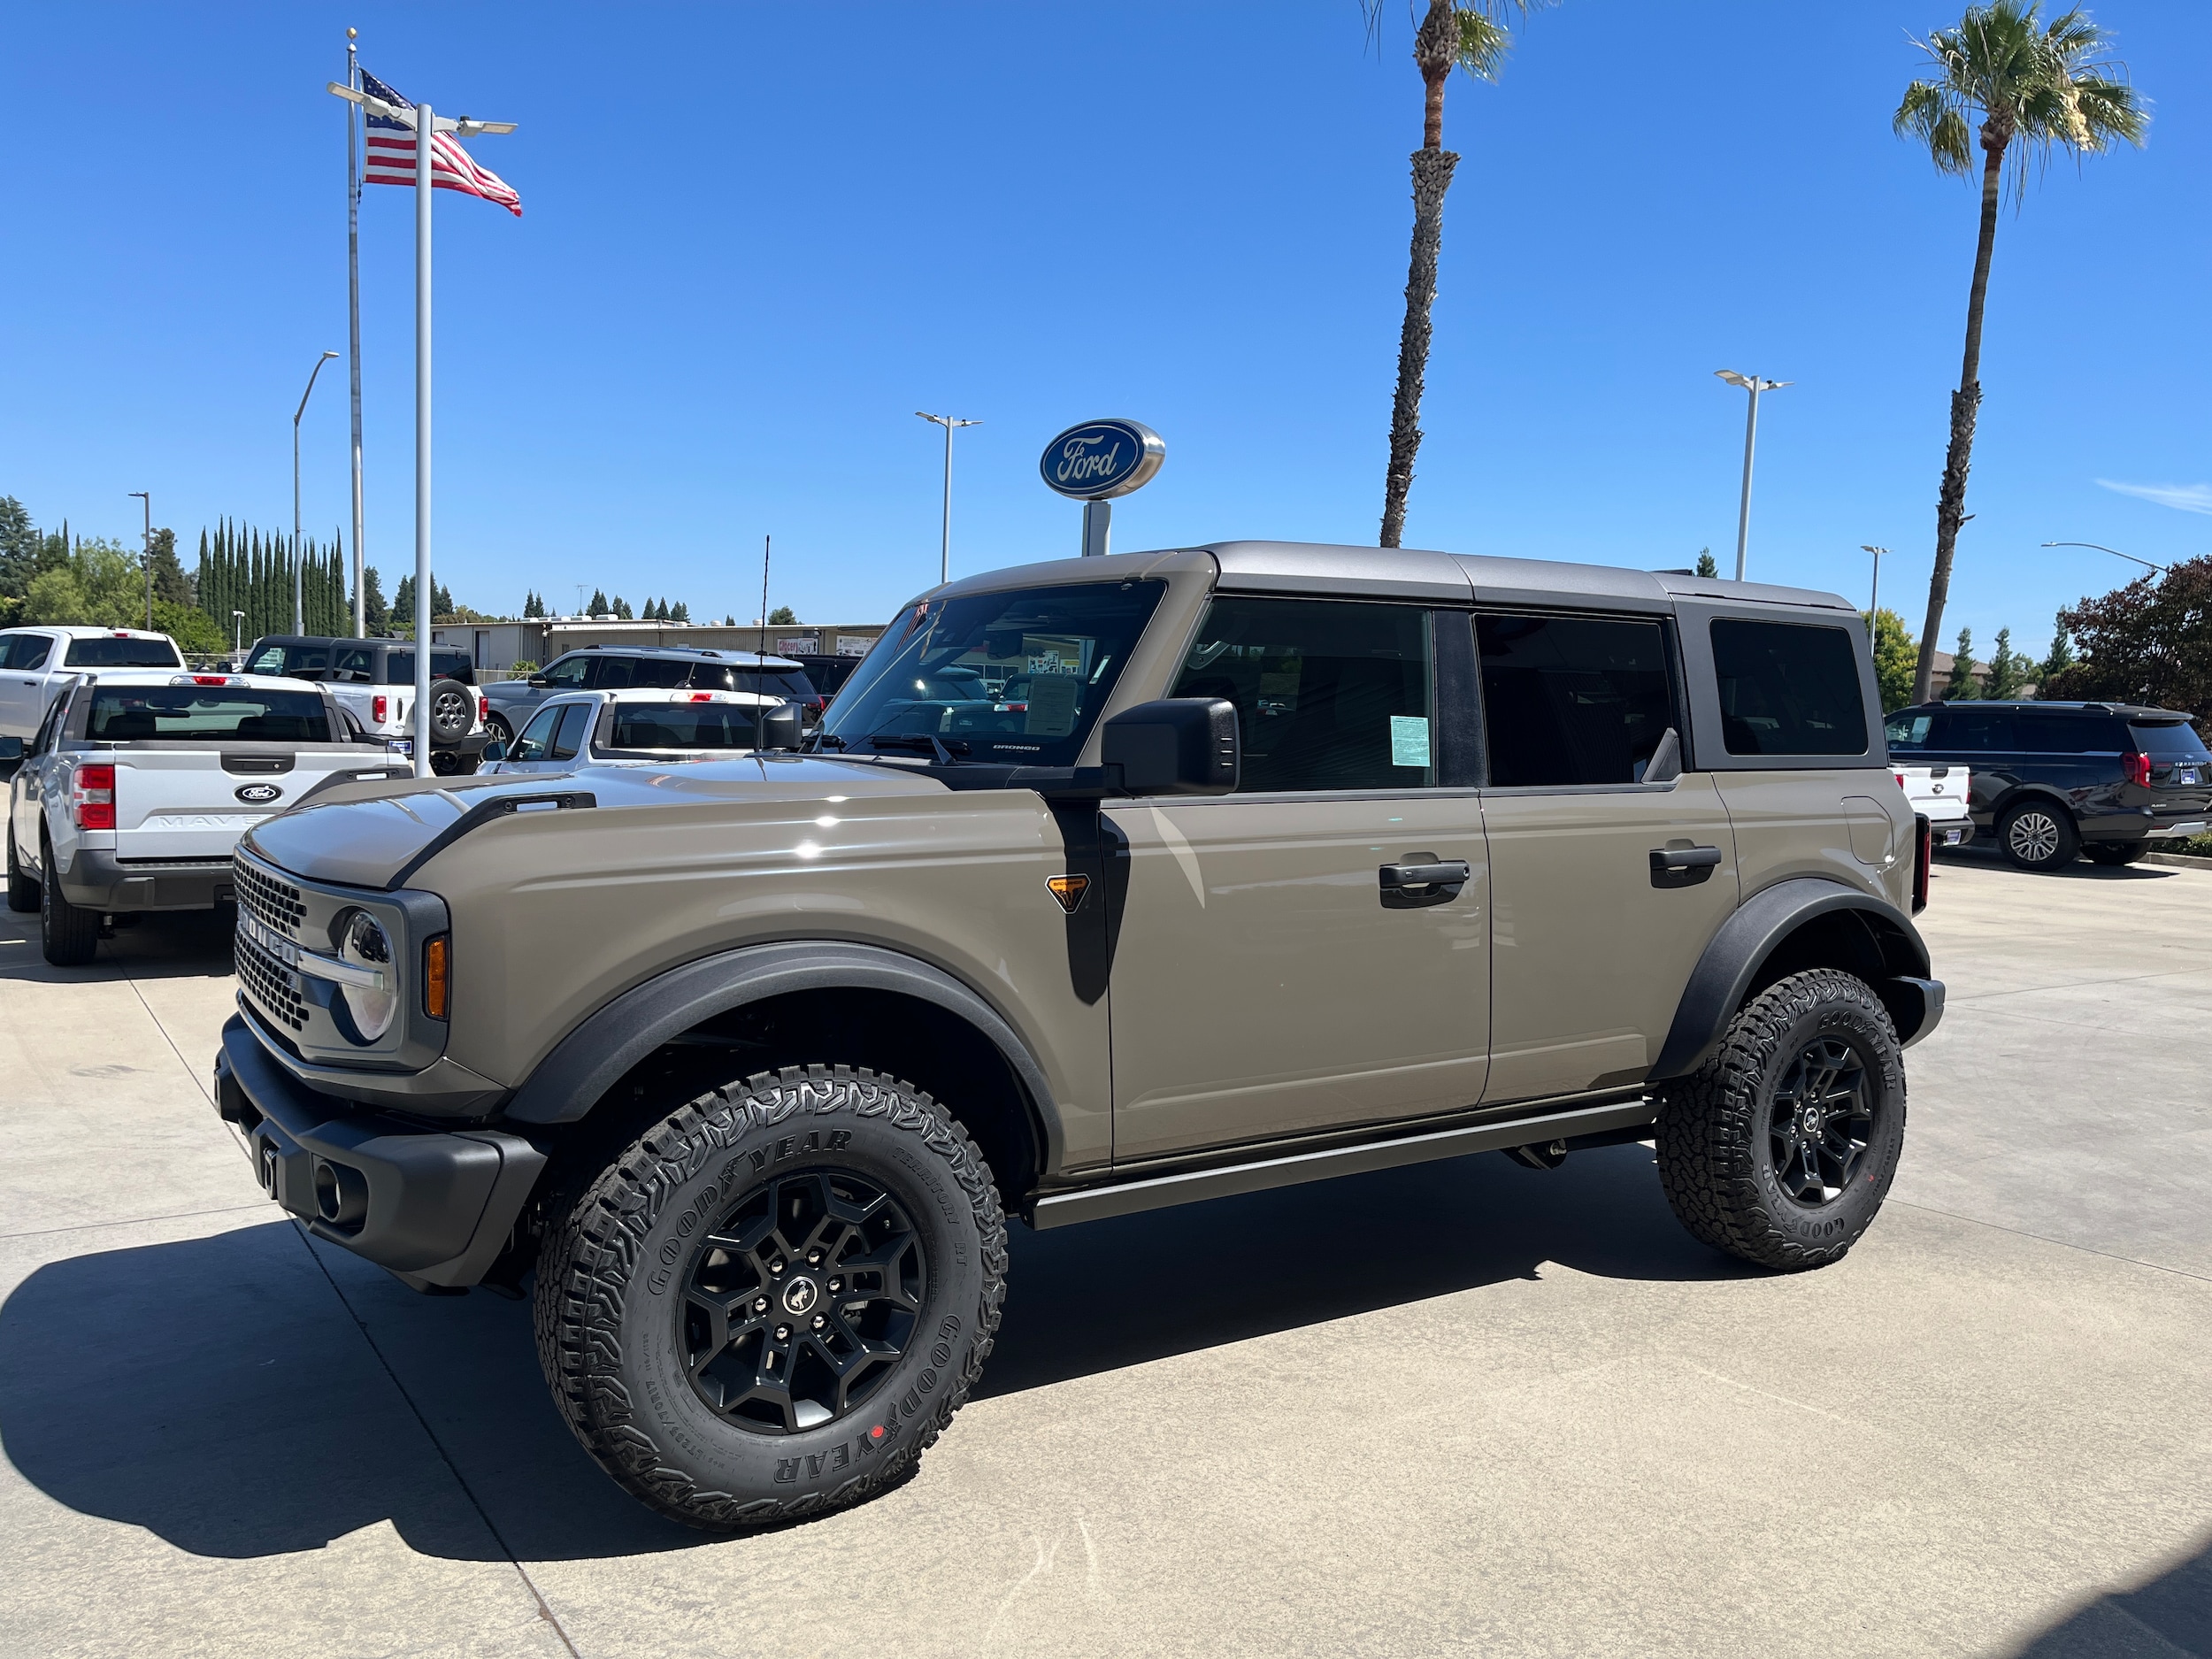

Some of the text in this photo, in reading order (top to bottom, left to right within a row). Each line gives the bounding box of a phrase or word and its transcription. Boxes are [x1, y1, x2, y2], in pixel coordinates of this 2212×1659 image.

[1056, 434, 1120, 482] Ford
[248, 786, 269, 797] Ford
[1818, 1010, 1896, 1091] GOODYEAR
[647, 1128, 853, 1296] GOODYEAR
[892, 1146, 960, 1225] TERRITORY
[955, 1241, 968, 1267] RT
[1761, 1162, 1846, 1238] GOODYEAR
[773, 1313, 962, 1483] GOODYEAR
